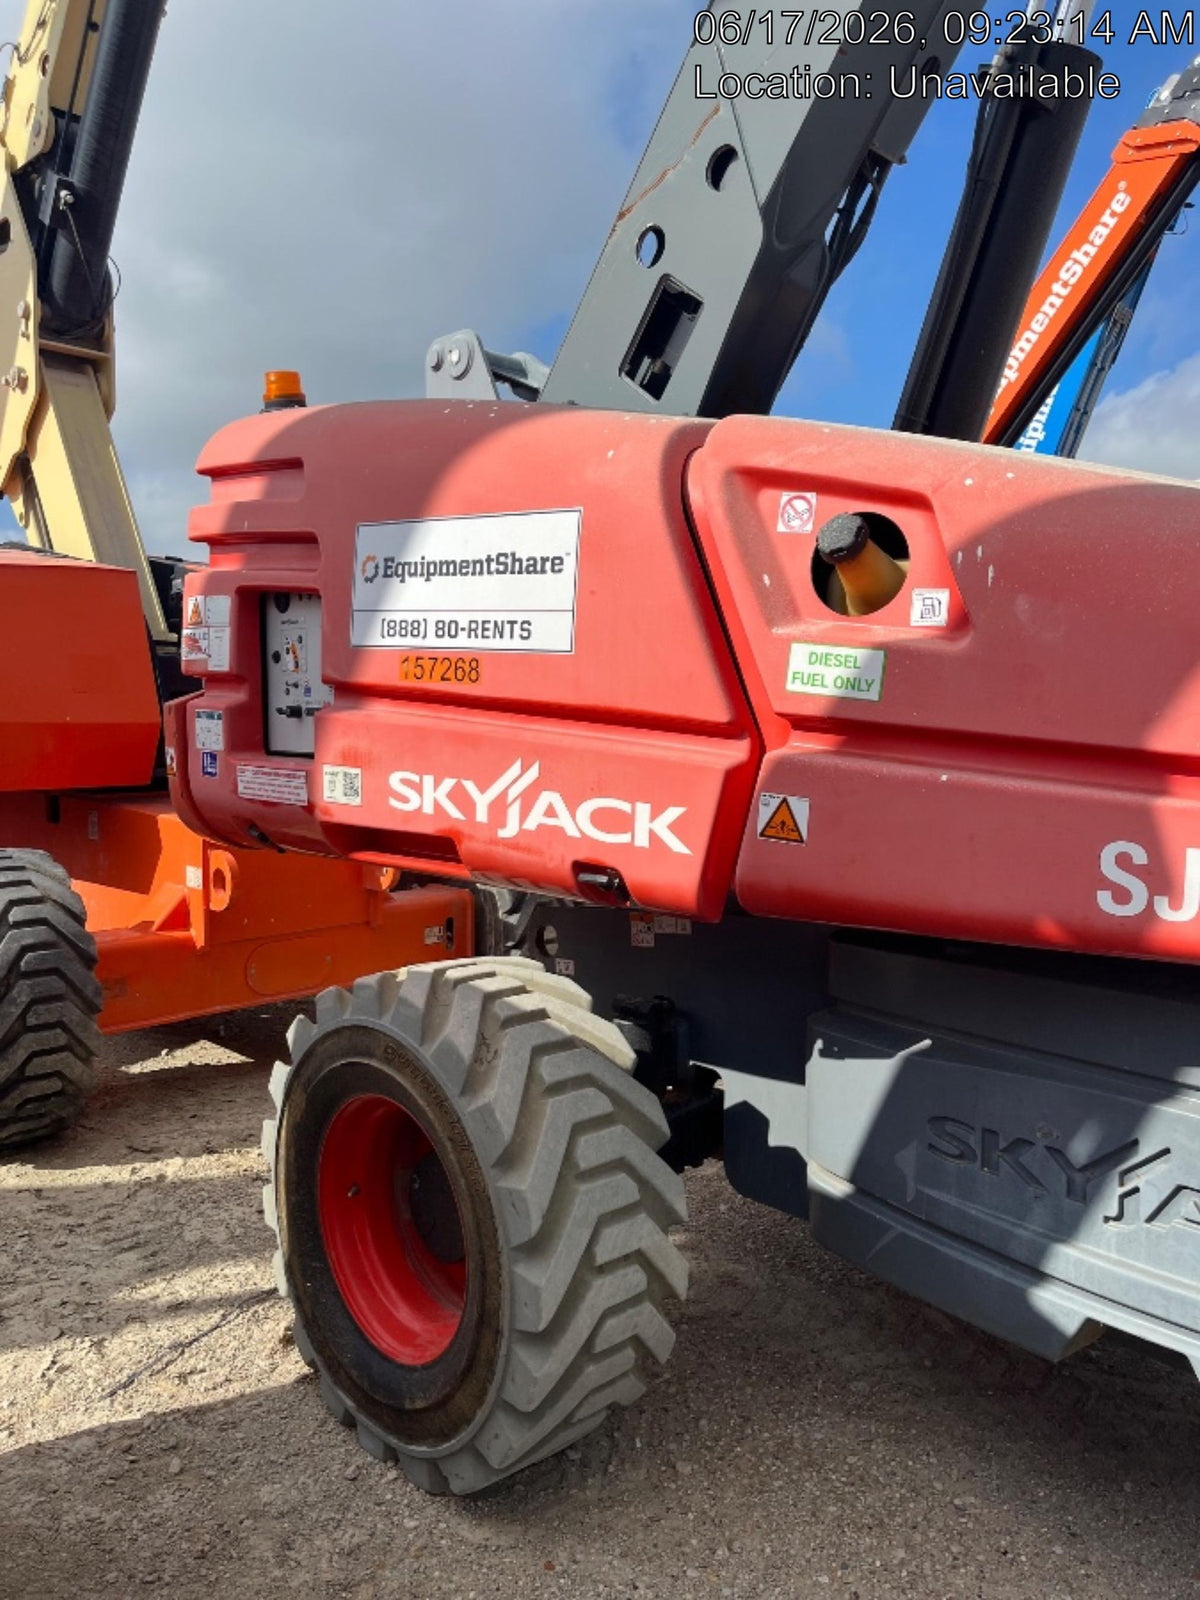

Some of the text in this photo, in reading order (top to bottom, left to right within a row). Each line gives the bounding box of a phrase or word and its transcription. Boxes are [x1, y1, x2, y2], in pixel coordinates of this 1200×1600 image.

[381, 551, 565, 584] EquipmentShare
[381, 618, 533, 641] (888) 80-RENTS
[400, 656, 481, 684] 157268
[807, 650, 862, 670] DIESEL
[790, 671, 876, 694] FUEL ONLY
[388, 757, 692, 855] SKYJACK
[1096, 840, 1200, 923] SJ
